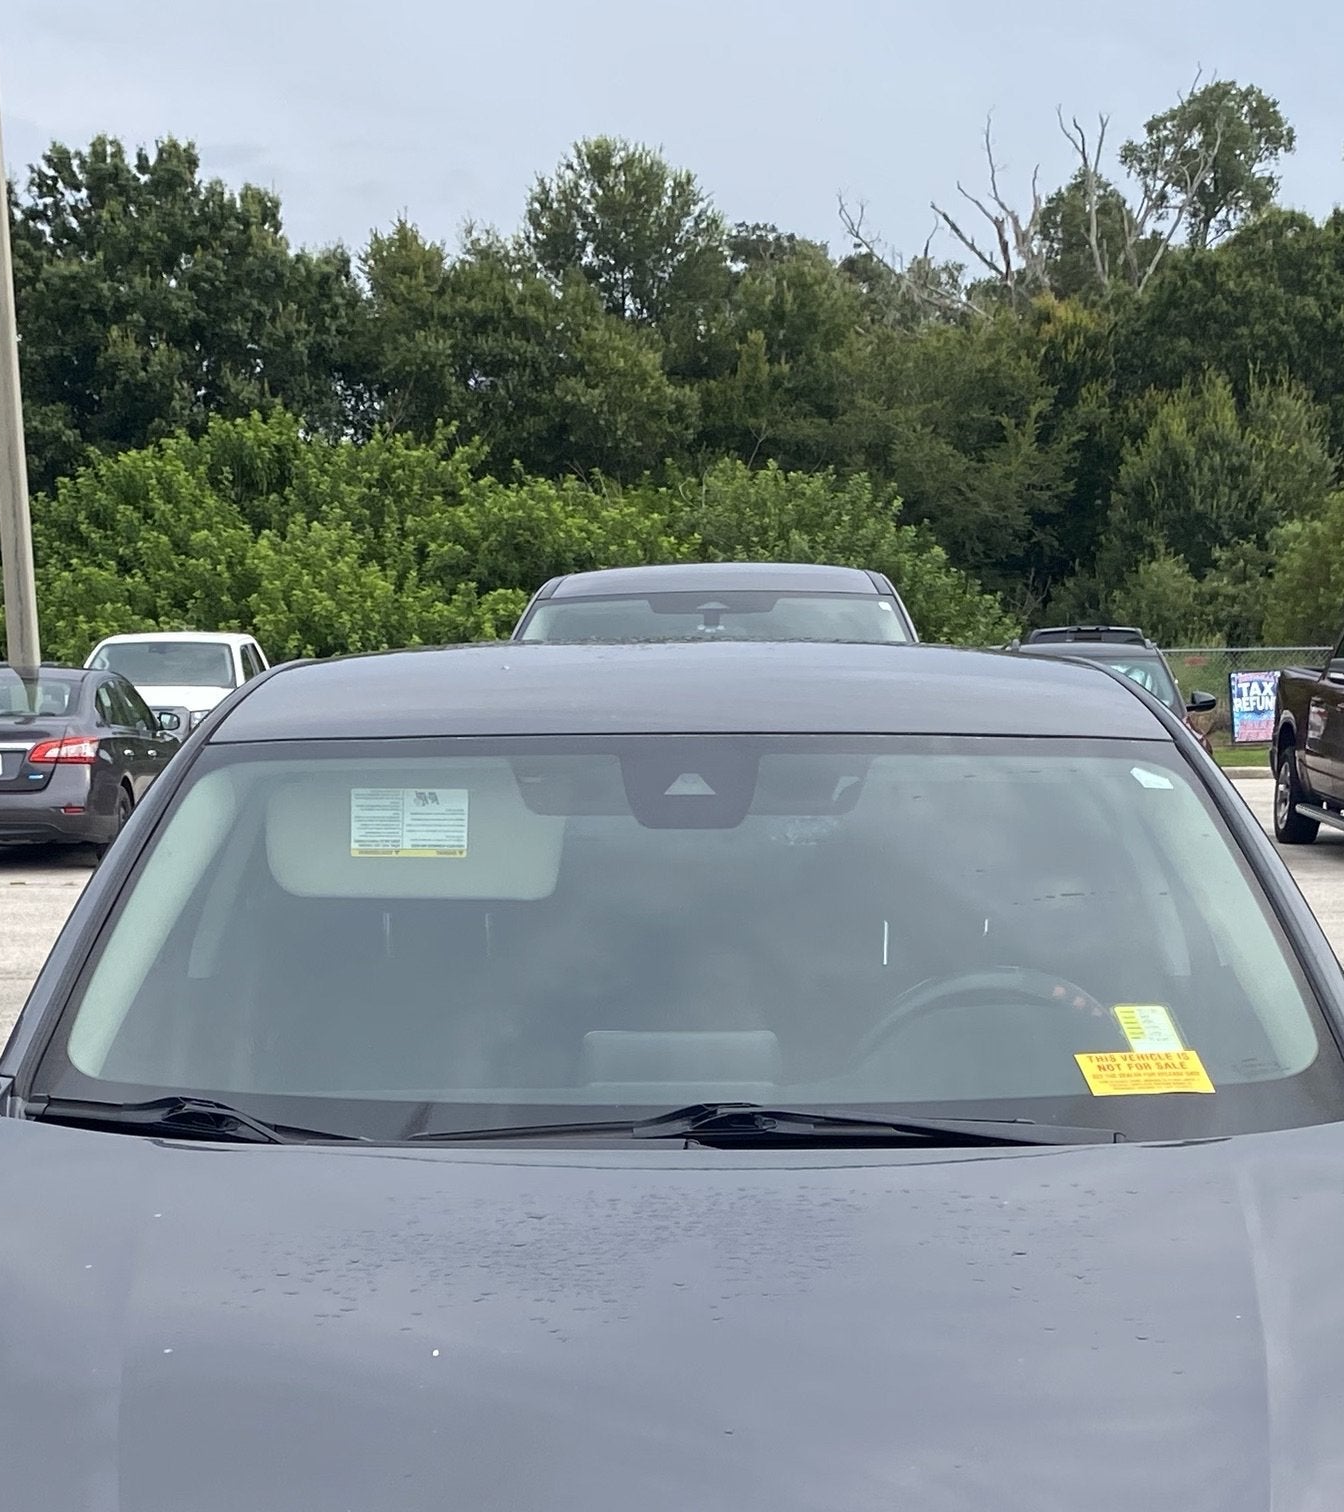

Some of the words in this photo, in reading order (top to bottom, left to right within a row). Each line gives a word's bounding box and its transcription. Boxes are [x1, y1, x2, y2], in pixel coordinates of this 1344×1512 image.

[1238, 681, 1274, 697] TAX
[1087, 1055, 1116, 1063] THIS
[1121, 1053, 1172, 1062] VEHICLE
[1177, 1052, 1190, 1060] IS
[1097, 1063, 1121, 1072] NOT
[1128, 1062, 1152, 1071] FOR
[1156, 1061, 1188, 1070] SALE
